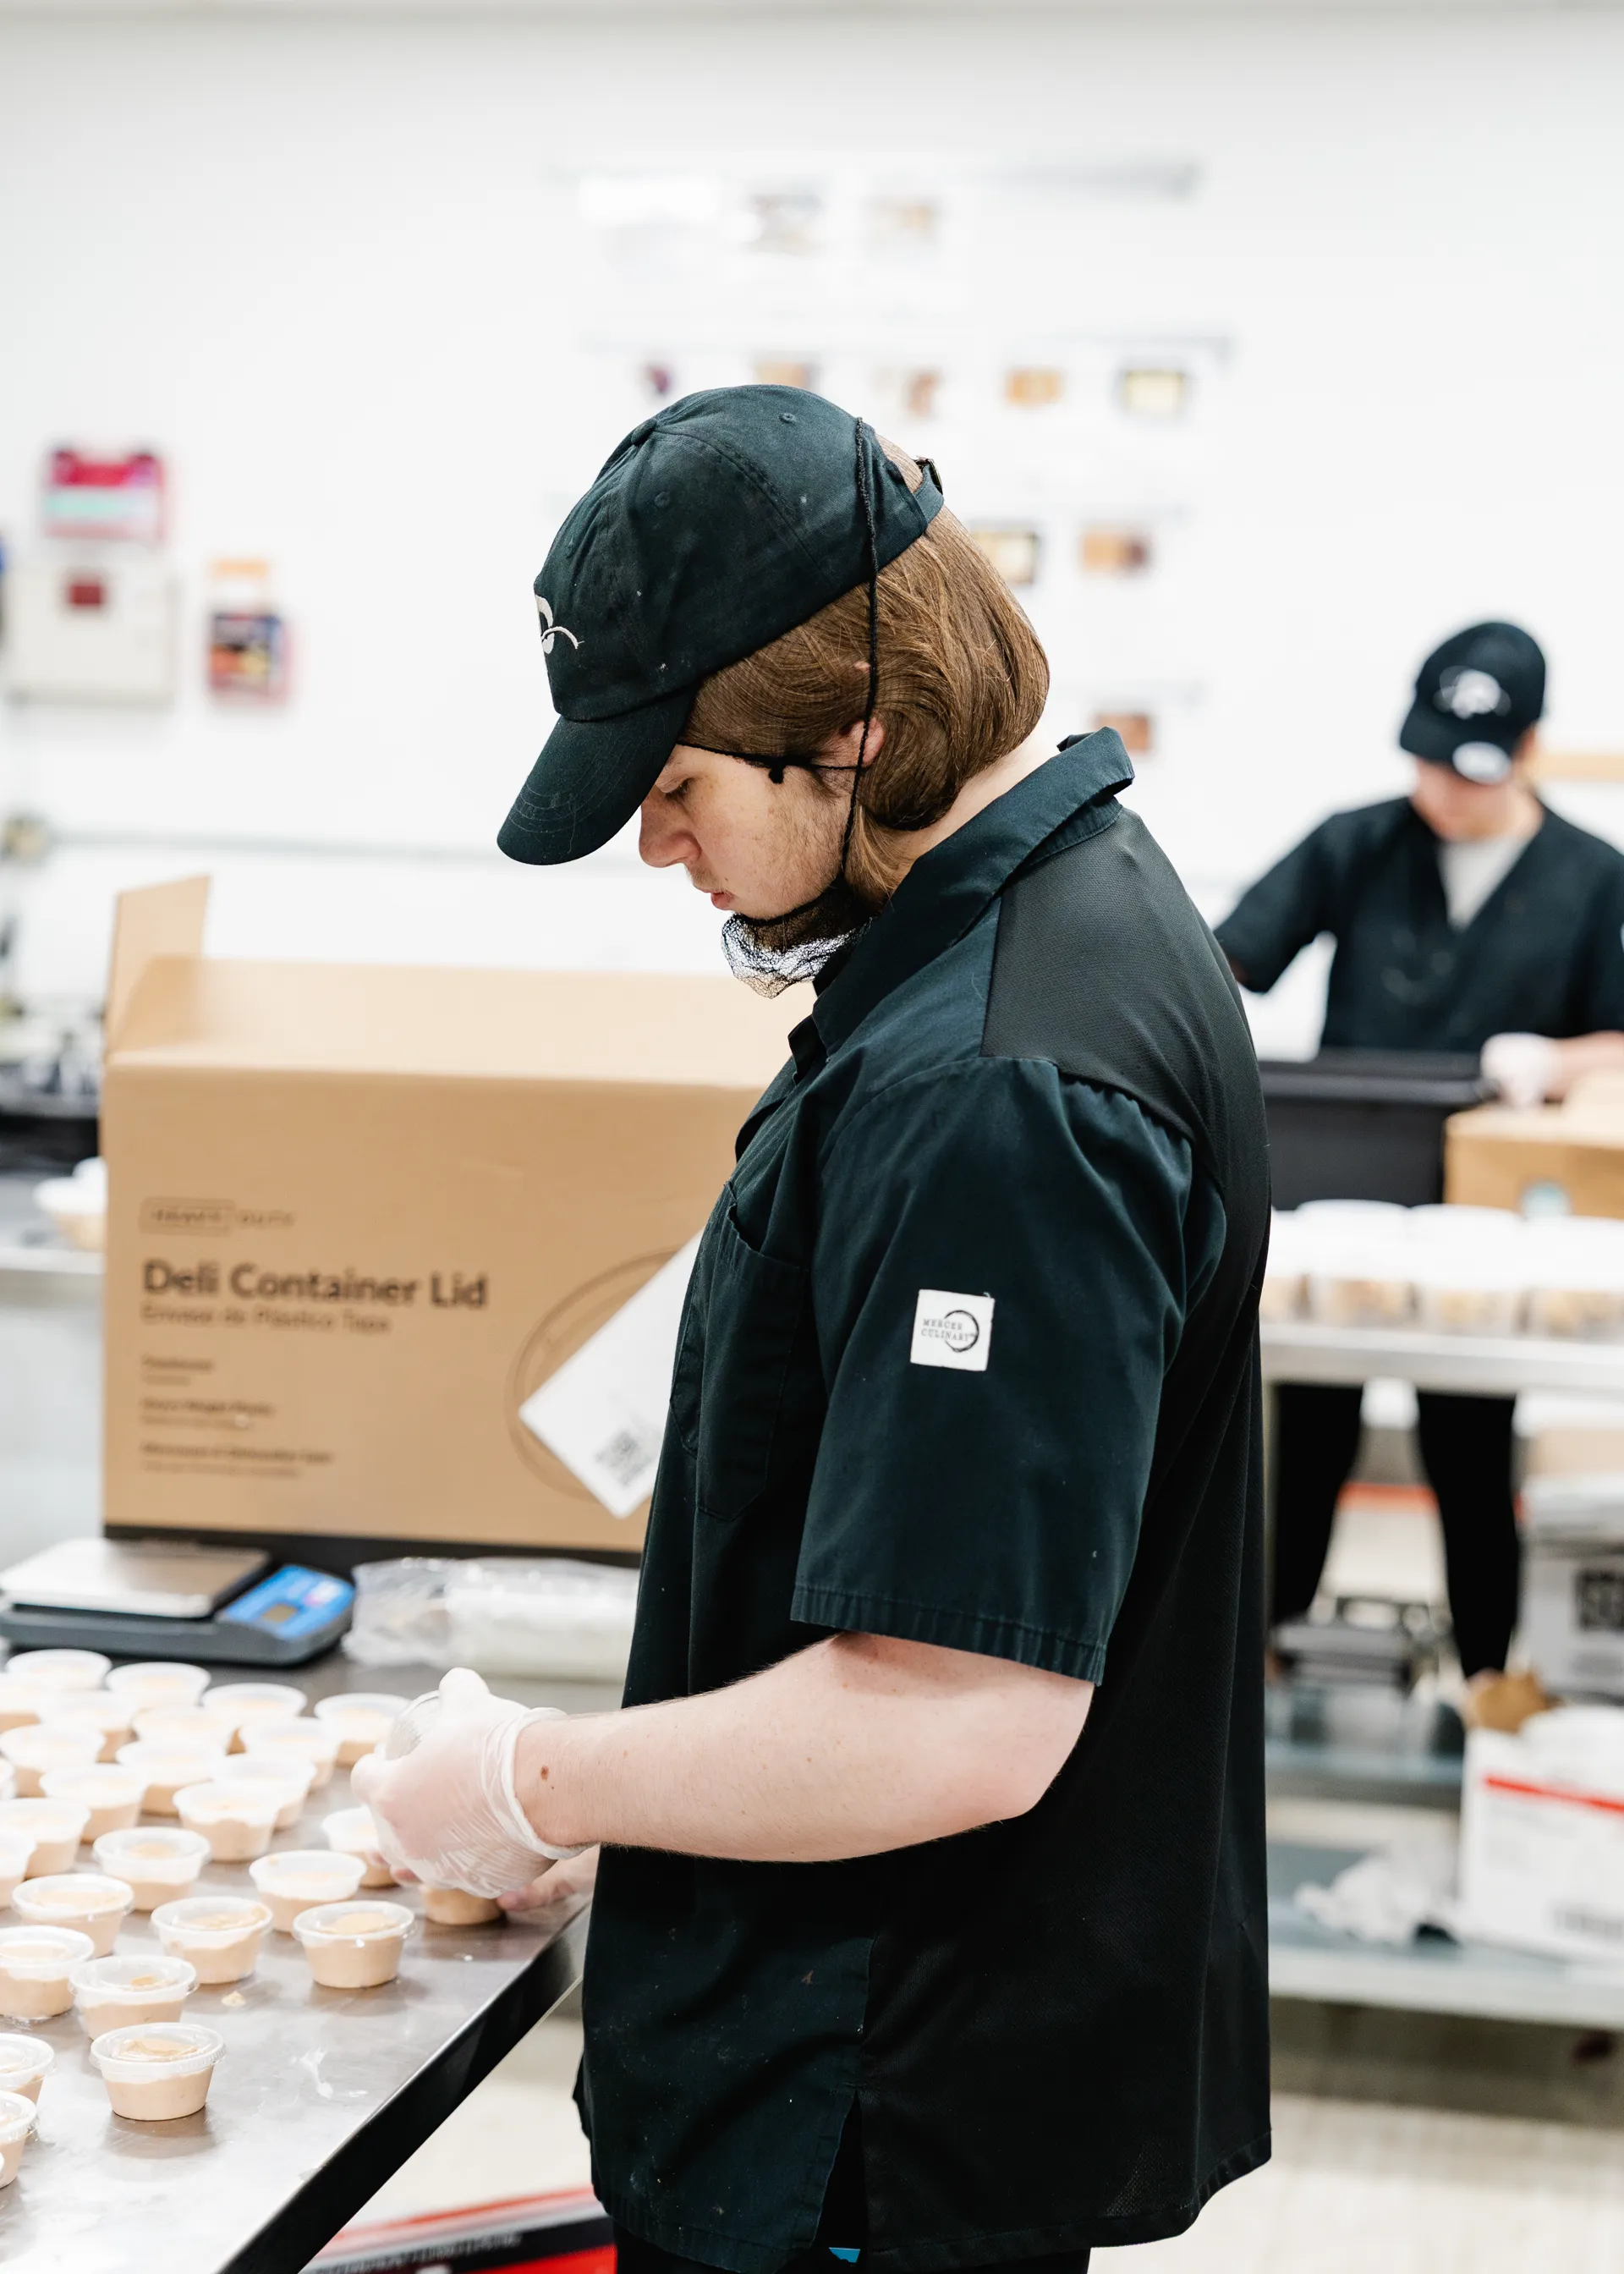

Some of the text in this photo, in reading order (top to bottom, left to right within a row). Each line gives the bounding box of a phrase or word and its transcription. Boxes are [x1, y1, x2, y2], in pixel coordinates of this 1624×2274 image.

[143, 1259, 488, 1310] Deli Container Lid
[923, 1319, 963, 1330] MERCER
